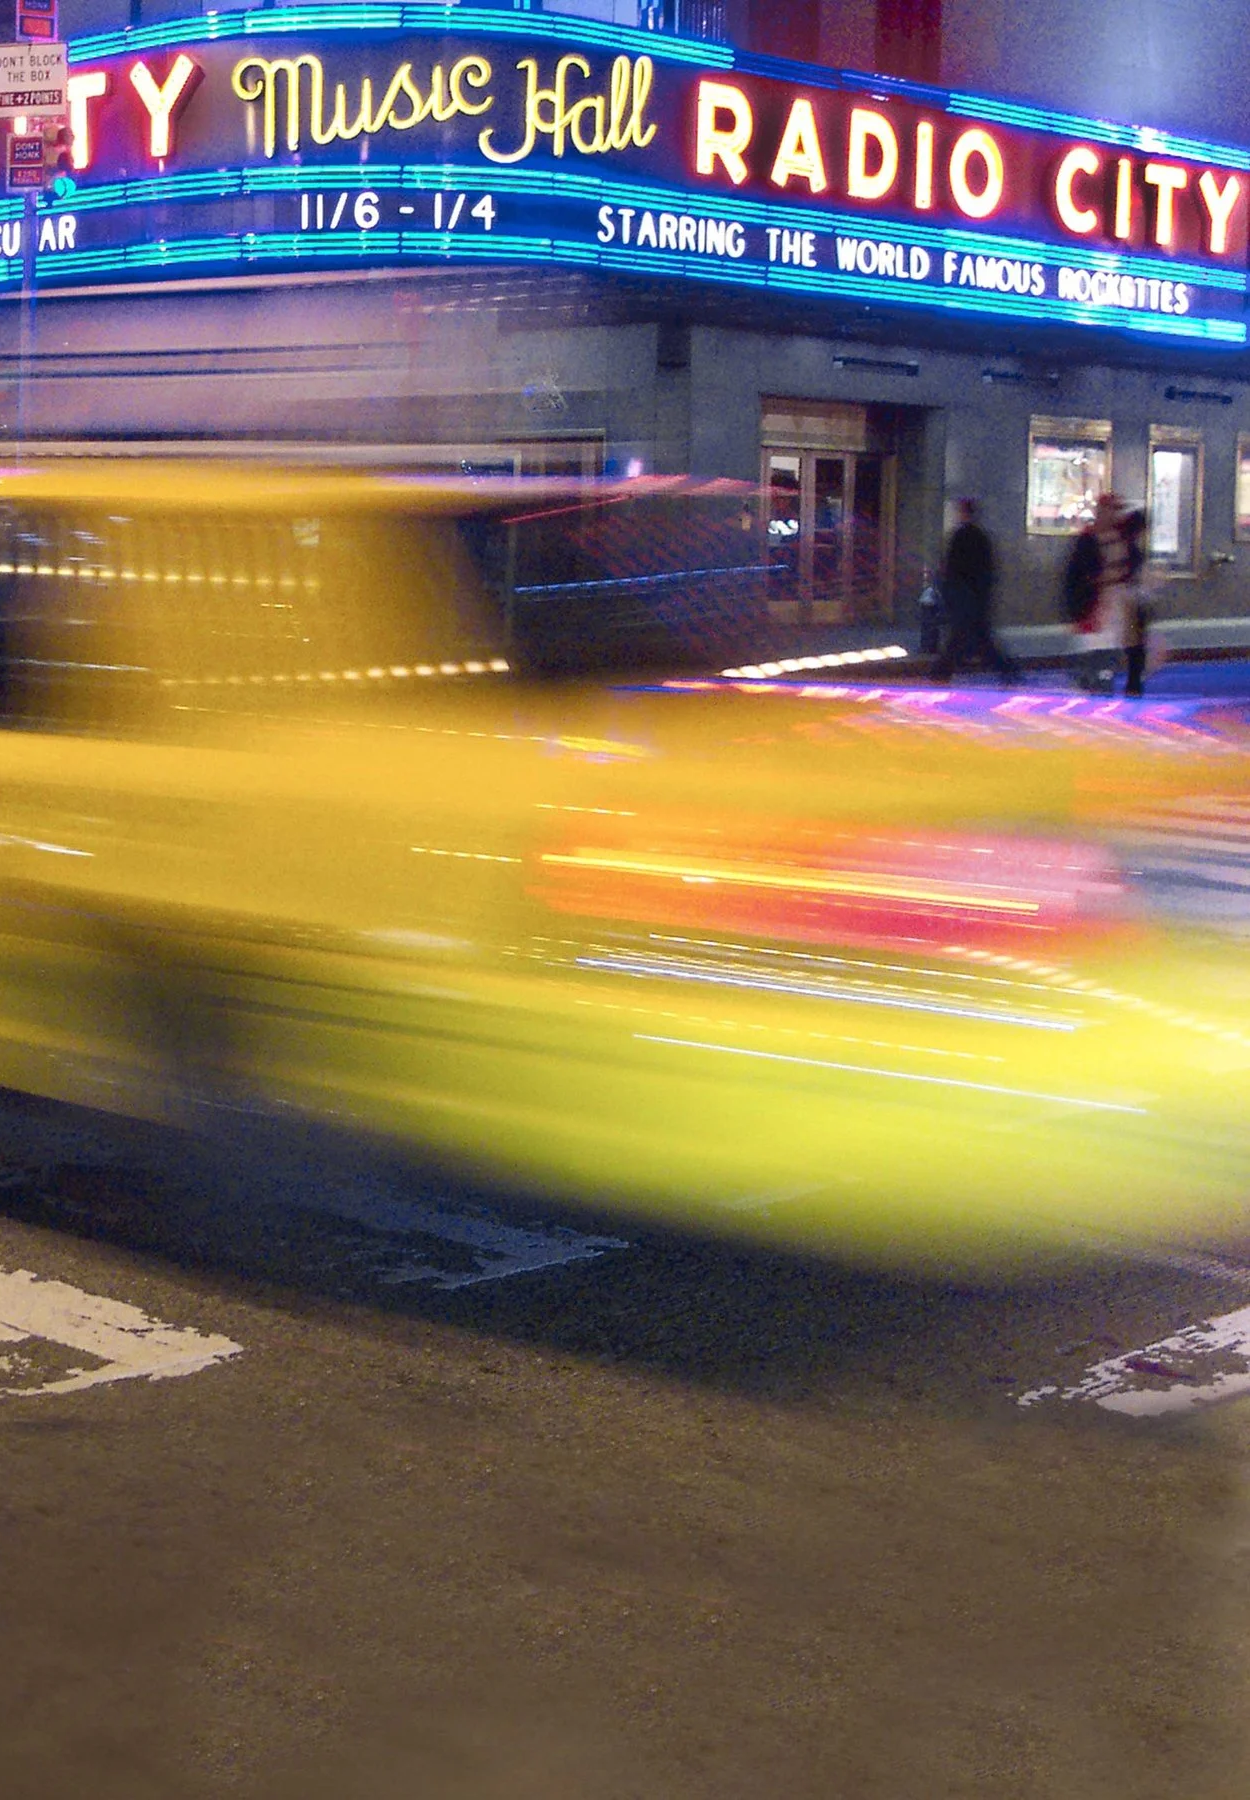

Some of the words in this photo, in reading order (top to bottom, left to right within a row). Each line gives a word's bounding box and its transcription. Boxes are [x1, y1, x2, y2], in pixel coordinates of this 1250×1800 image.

[8, 71, 25, 82] THE
[30, 70, 50, 82] BOX
[30, 54, 62, 67] BLOCK
[232, 53, 494, 159] Music
[478, 54, 657, 163] Hall
[696, 79, 1004, 219] RADIO
[1056, 146, 1241, 254] CITY
[301, 192, 380, 231] 11/6
[433, 193, 496, 231] 1/4
[597, 205, 746, 258] STARRING
[766, 227, 817, 267] THE
[836, 236, 930, 280] WORLD
[943, 250, 1046, 296] FAMOUS
[1057, 266, 1190, 315] ROCKETTES
